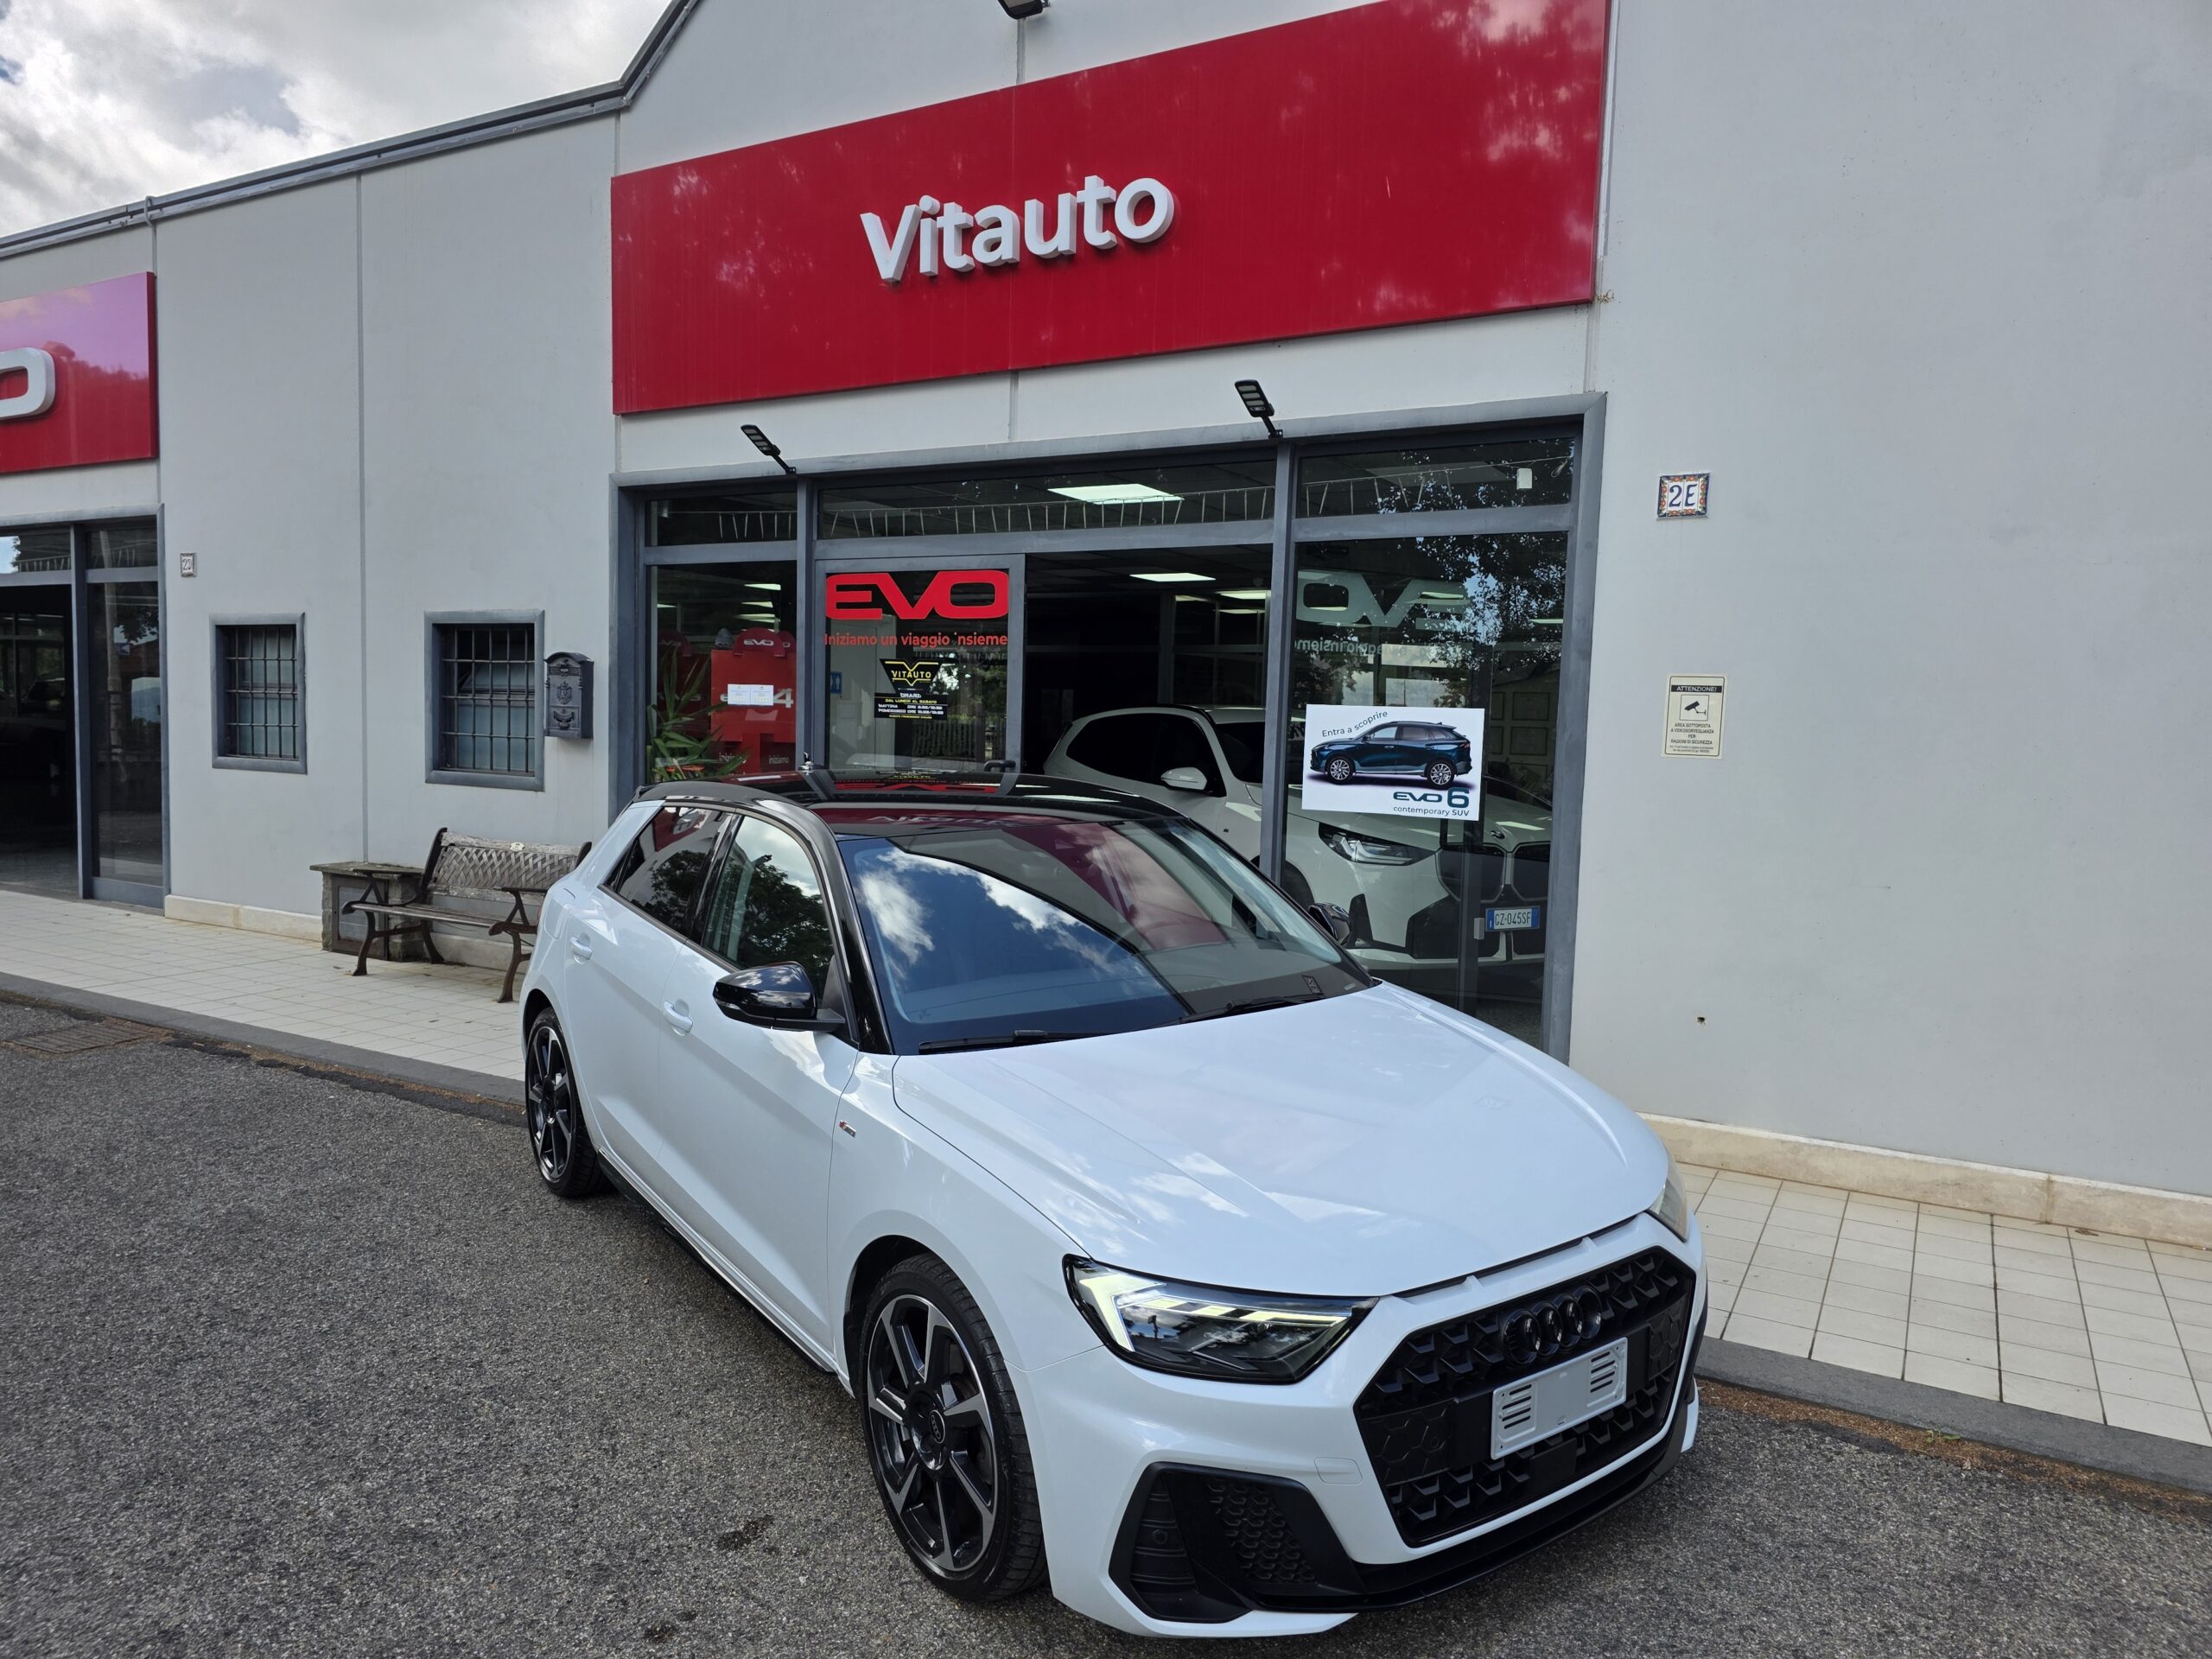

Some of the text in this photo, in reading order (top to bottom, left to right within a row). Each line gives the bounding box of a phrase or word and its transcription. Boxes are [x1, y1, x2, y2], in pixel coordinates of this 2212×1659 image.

[860, 175, 1174, 283] Vitauto
[1669, 483, 1698, 507] 2E
[826, 570, 1008, 620] EVO
[881, 635, 897, 645] un
[901, 632, 950, 649] viaggio
[953, 632, 1007, 645] nsieme
[1322, 728, 1344, 737] Entra
[1354, 711, 1388, 731] scoprire
[1393, 787, 1470, 809] EVO 6
[1393, 806, 1450, 817] contemporary
